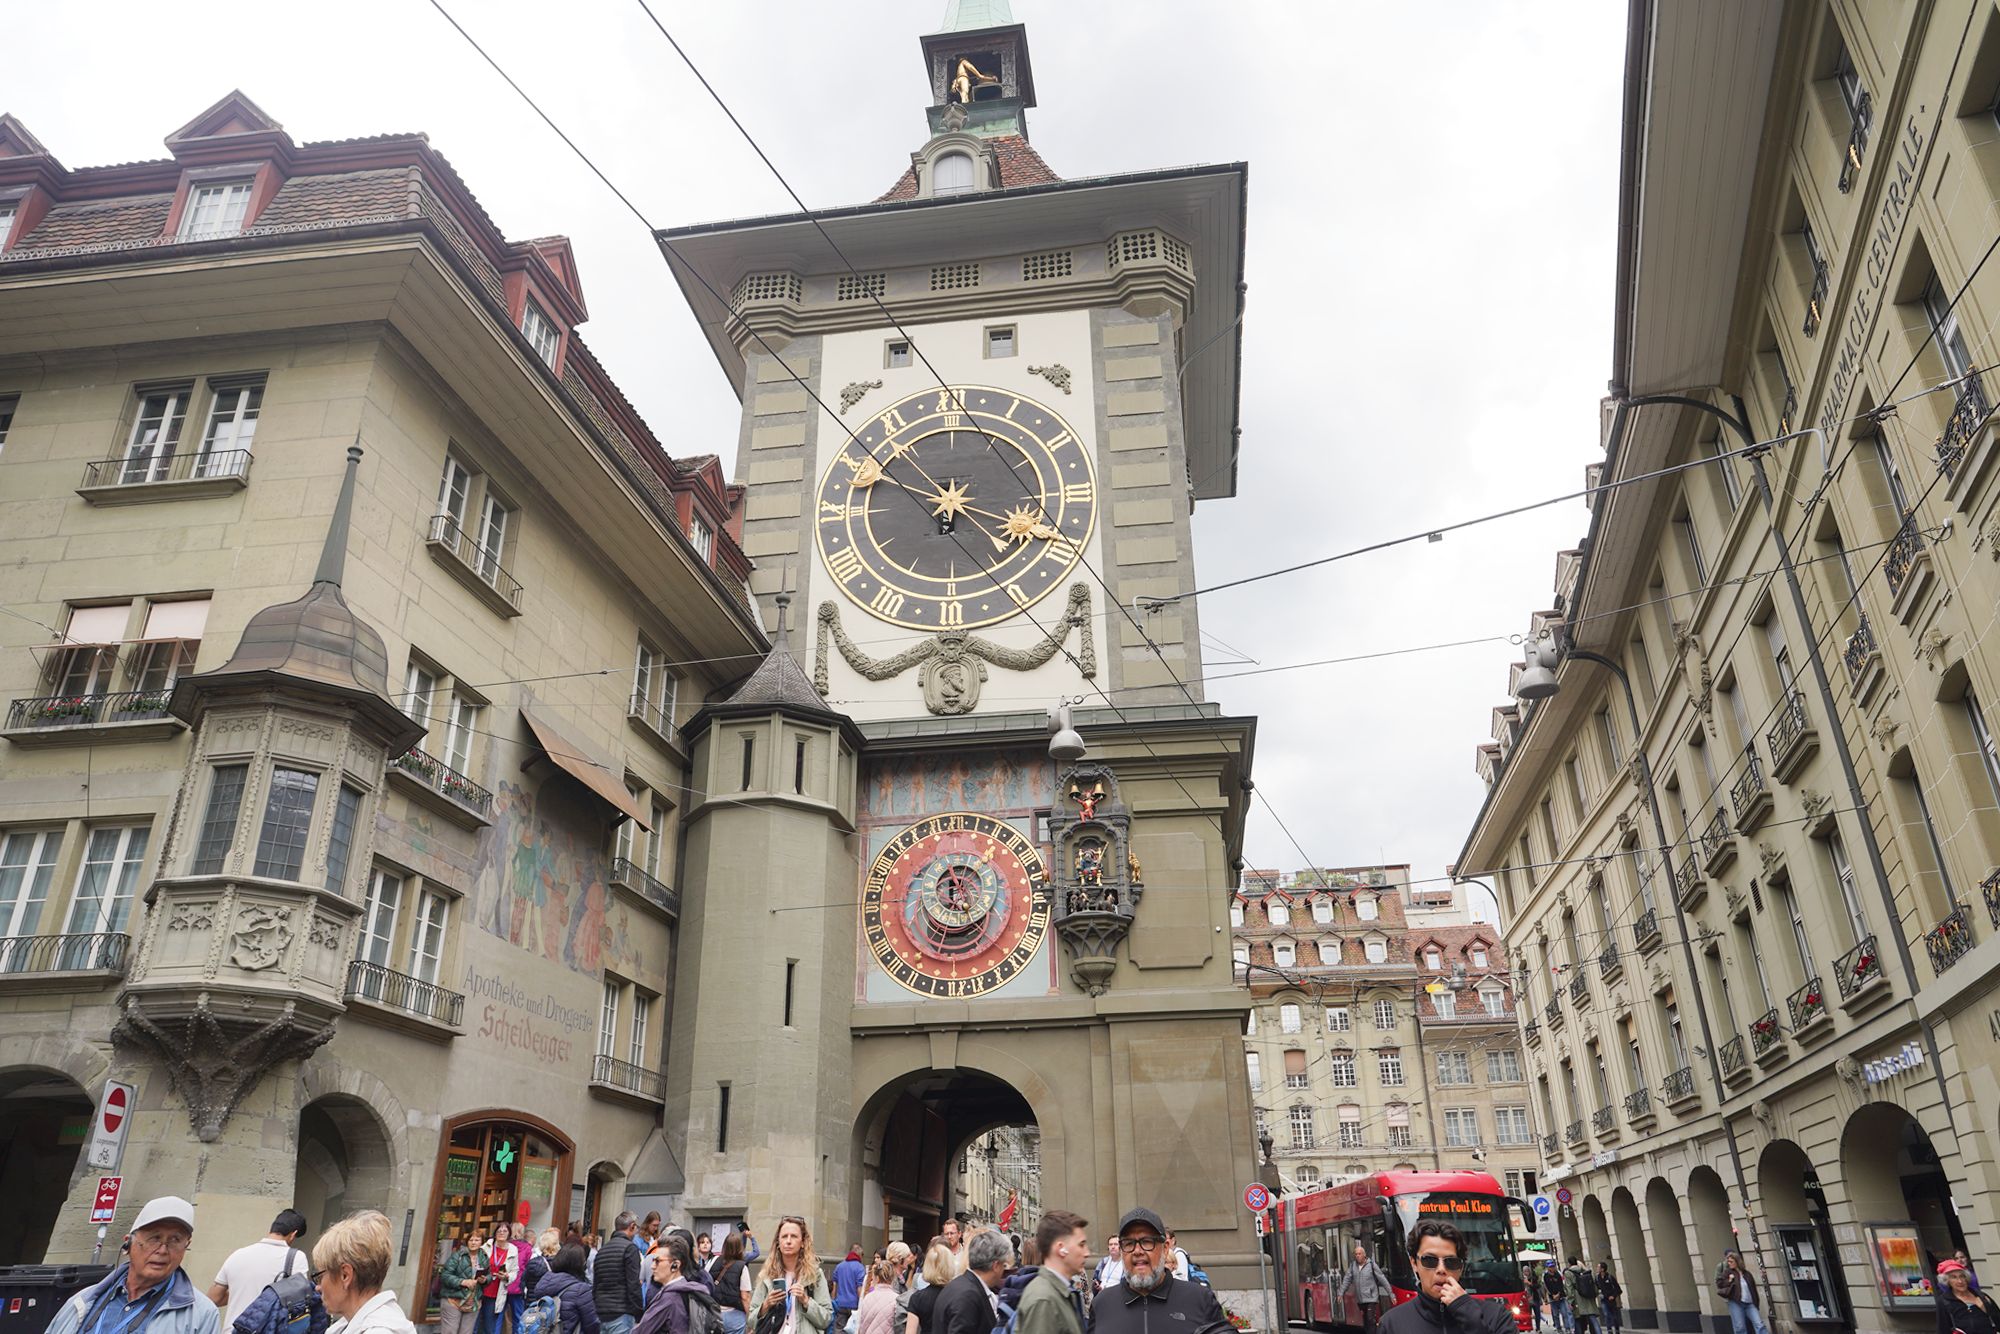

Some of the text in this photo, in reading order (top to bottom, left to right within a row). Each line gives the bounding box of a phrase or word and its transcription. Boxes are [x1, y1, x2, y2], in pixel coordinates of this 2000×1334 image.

[463, 965, 593, 1034] Apotheke und Drogerie
[478, 1004, 573, 1065] Scheidegger
[1450, 1199, 1470, 1213] Paul
[1471, 1199, 1492, 1213] Klee
